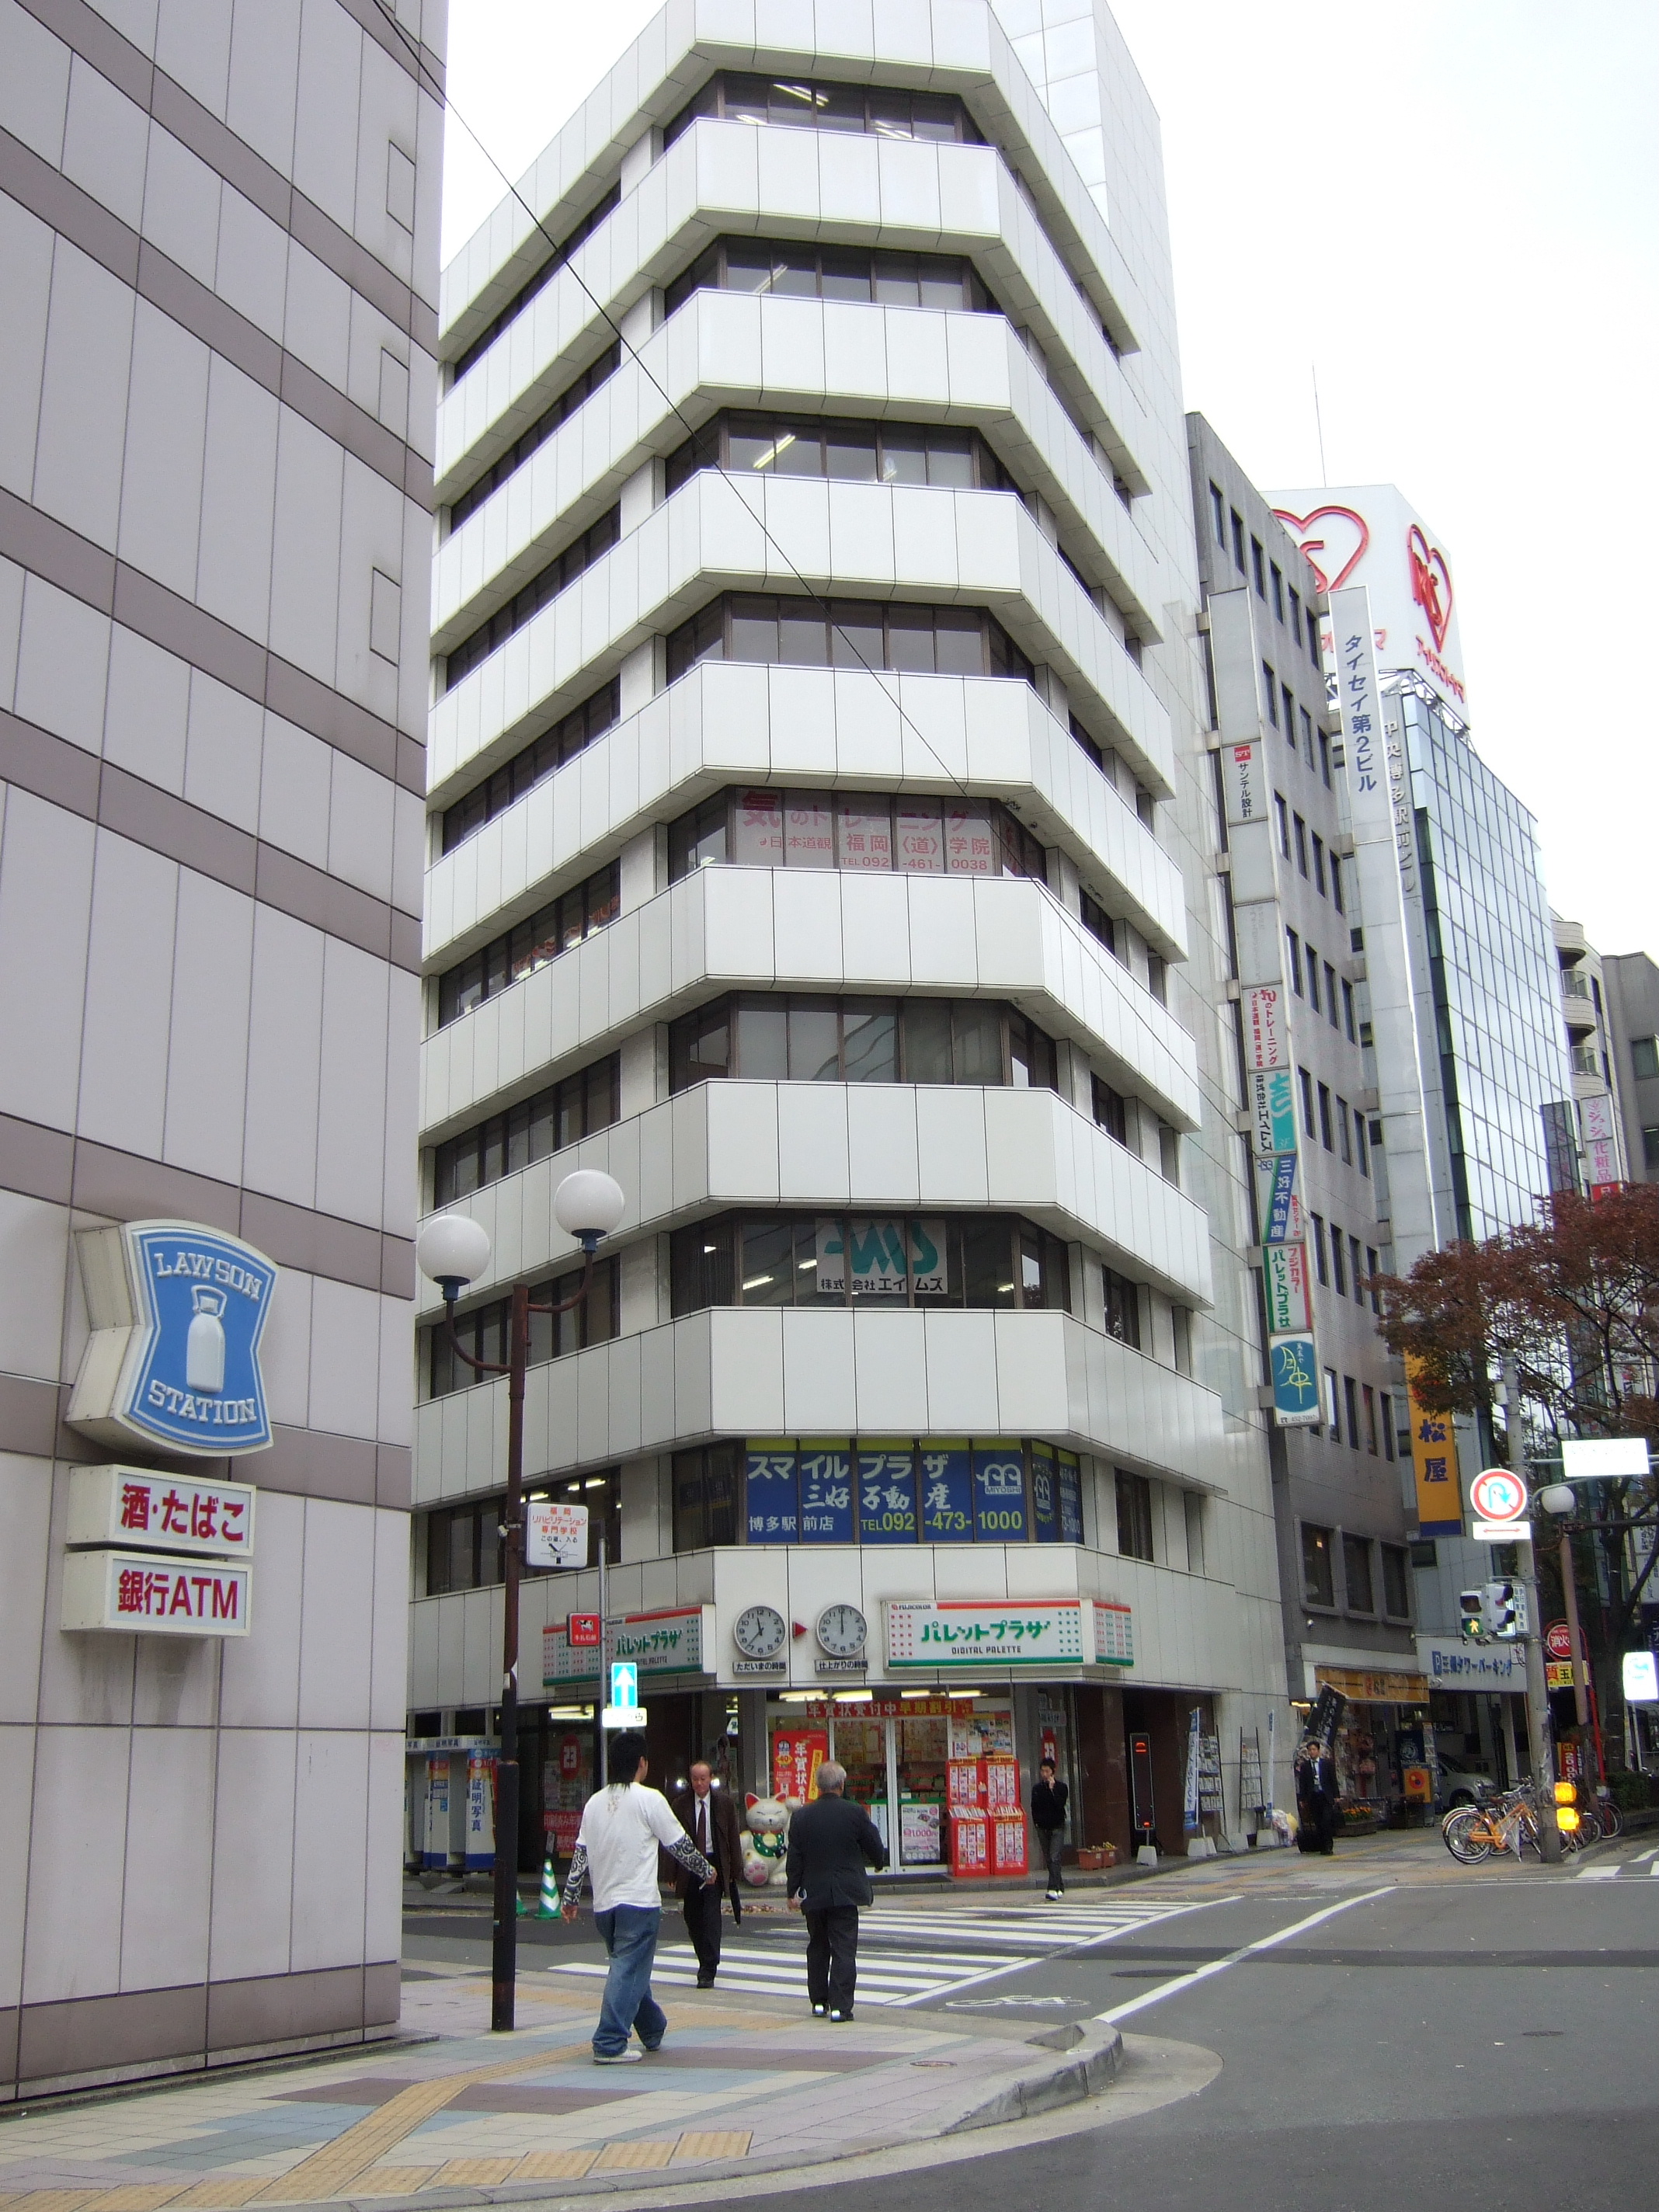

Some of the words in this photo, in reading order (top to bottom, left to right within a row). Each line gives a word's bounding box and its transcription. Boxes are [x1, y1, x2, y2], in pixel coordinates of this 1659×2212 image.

[1344, 635, 1377, 793] タイセイ第2ビル
[1255, 1074, 1273, 1153] 株式会社エイムズ
[1270, 1160, 1292, 1237] 三好不動産
[155, 1252, 263, 1302] LAWSON
[821, 1278, 944, 1292] 株式会社エイムズ
[1271, 1249, 1291, 1328] パレットプラザ
[1288, 1247, 1301, 1294] フジカラー
[148, 1379, 257, 1425] STATION
[747, 1453, 950, 1480] スマイルプラザ
[1418, 1418, 1449, 1483] 松屋
[802, 1484, 951, 1511] 三好不動産
[985, 1486, 1022, 1494] MIYOSHI
[748, 1515, 834, 1532] 博多駅前店
[118, 1569, 238, 1619] 銀行ATM
[616, 1628, 683, 1657] パレットプラザ
[921, 1619, 1051, 1643] パレットプラザ
[951, 1646, 983, 1654] DIGITAL
[986, 1645, 1022, 1654] PALETTE
[1551, 1634, 1570, 1647] 消火
[809, 1702, 896, 1718] 年賀状受付中
[471, 1779, 482, 1832] 証明写真
